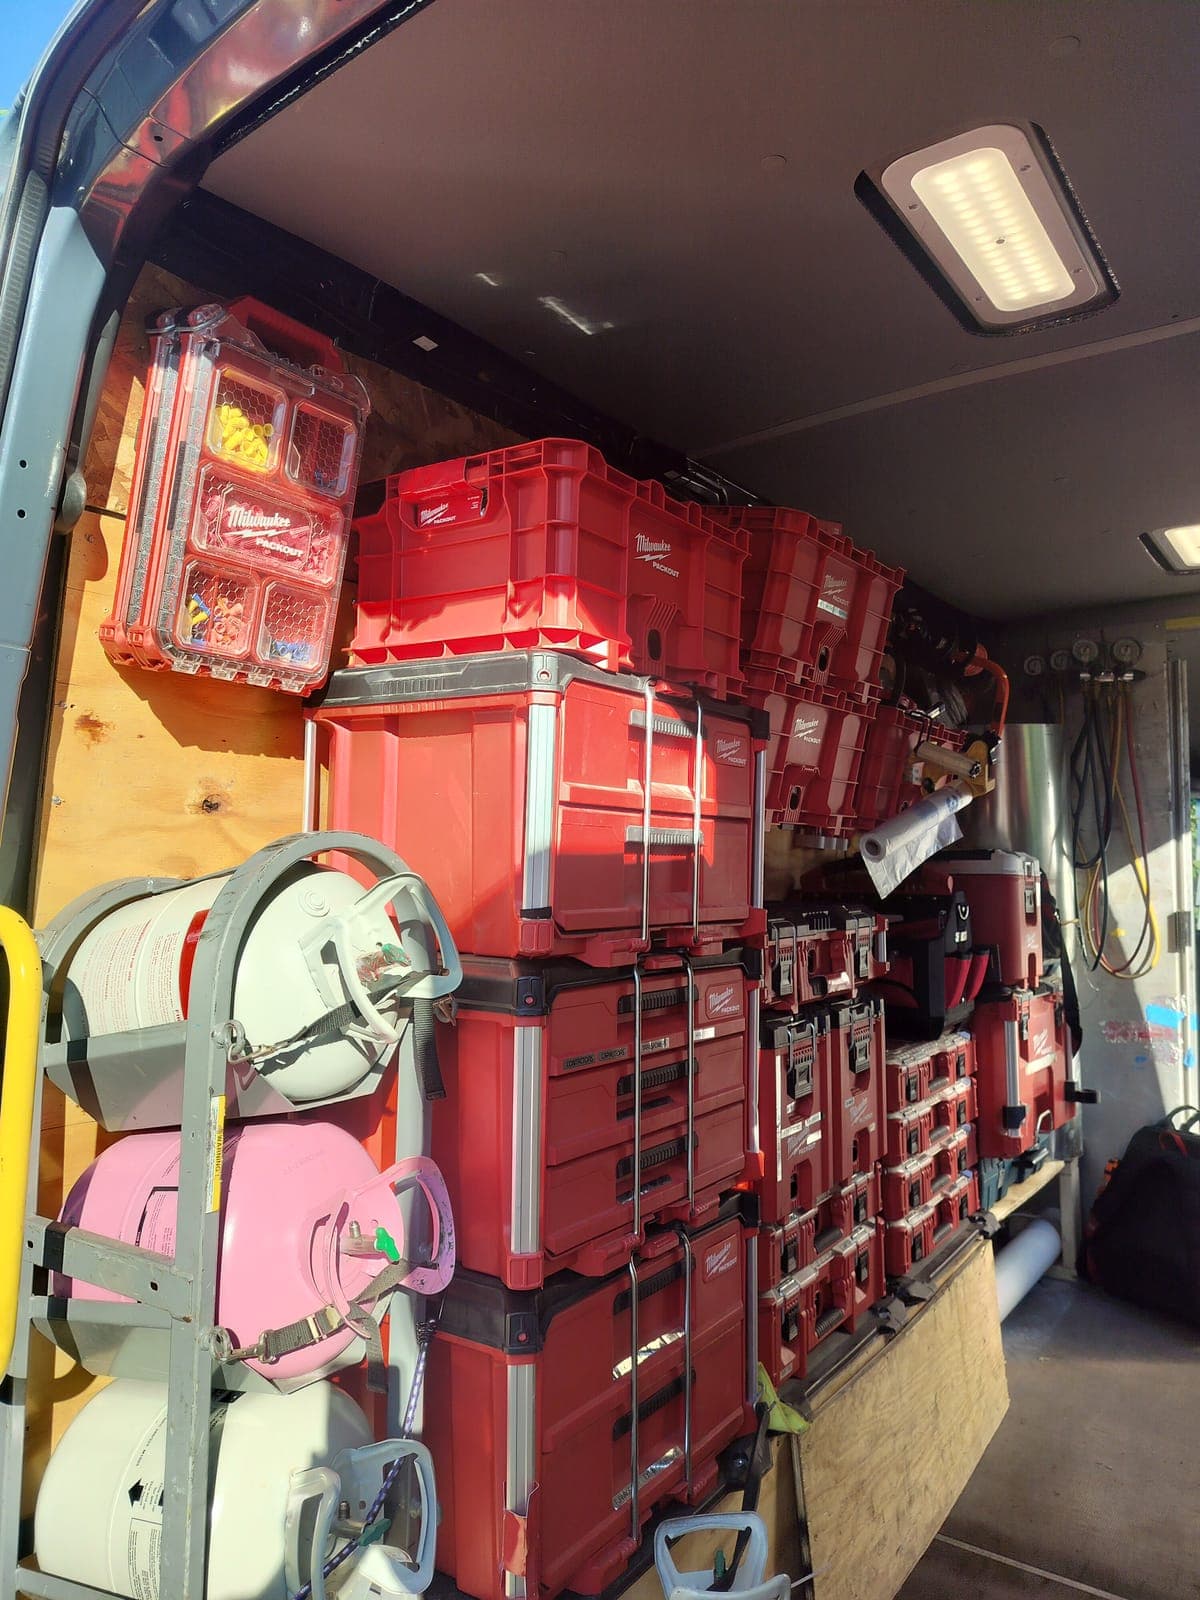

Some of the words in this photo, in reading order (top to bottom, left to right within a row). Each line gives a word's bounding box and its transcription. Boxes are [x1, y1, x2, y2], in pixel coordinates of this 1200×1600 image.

[226, 504, 291, 528] Milwaukee
[256, 537, 303, 557] PACKOUT
[635, 533, 671, 552] Milwaukee
[653, 561, 679, 577] PACKOUT
[717, 738, 740, 753] Milwaukee
[709, 986, 733, 1010] Milwaukee
